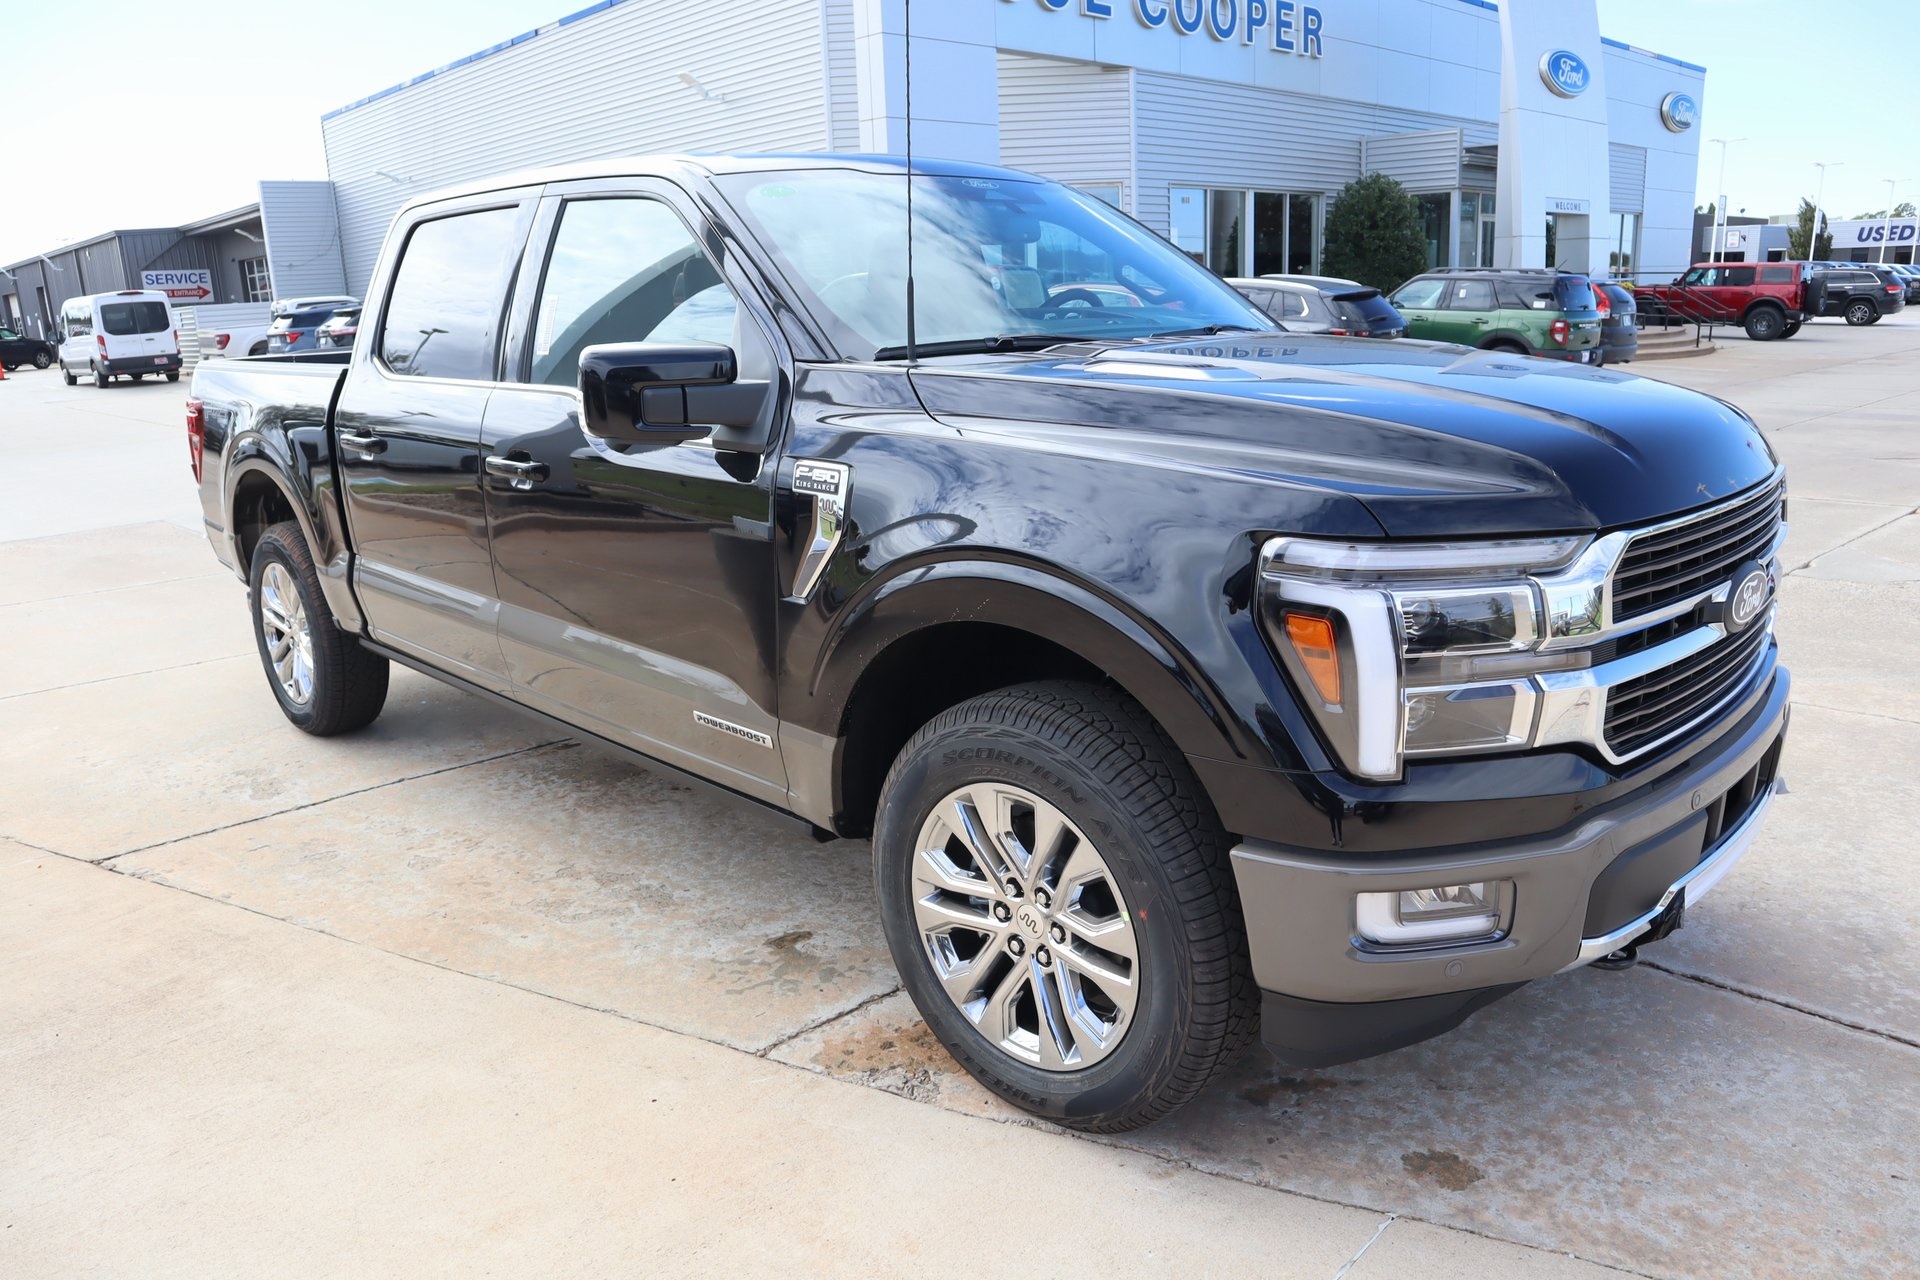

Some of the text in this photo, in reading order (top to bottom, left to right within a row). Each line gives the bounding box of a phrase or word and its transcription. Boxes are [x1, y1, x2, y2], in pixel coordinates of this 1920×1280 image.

[1559, 57, 1584, 86] Ford
[1675, 101, 1697, 122] Ford
[1555, 201, 1581, 211] WELCOME
[1857, 225, 1916, 242] USED
[145, 272, 208, 285] SERVICE
[174, 289, 204, 297] ENTRANCE
[796, 480, 835, 491] KING RANCH
[1740, 578, 1763, 617] Ford
[696, 714, 767, 745] POWERBOOST
[943, 747, 1087, 804] SCORPION
